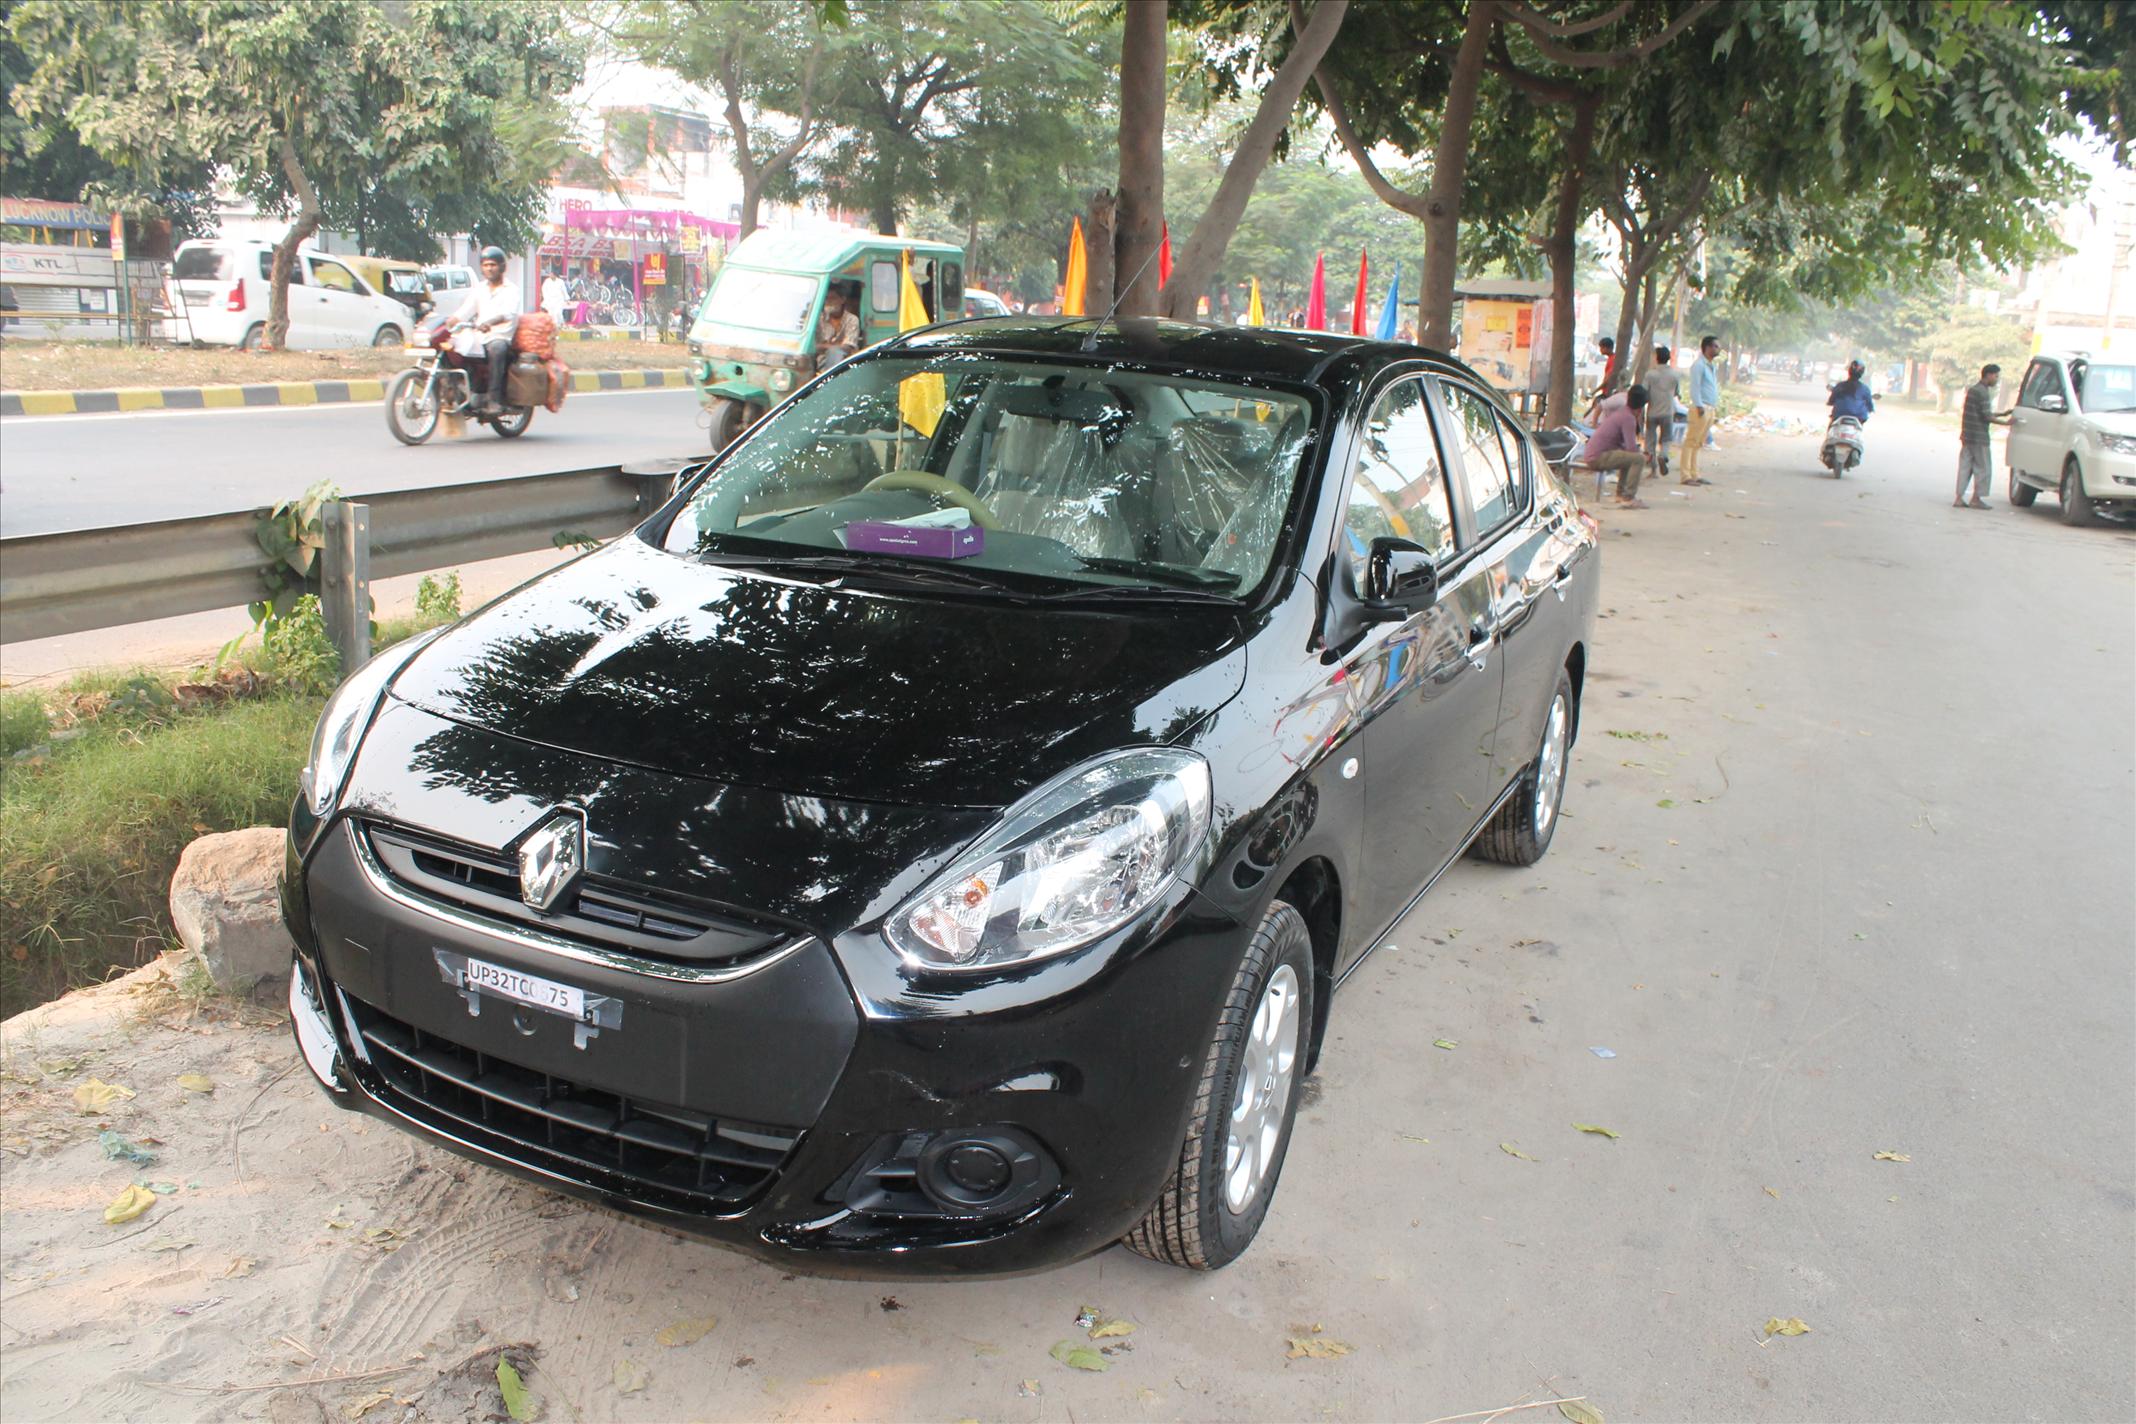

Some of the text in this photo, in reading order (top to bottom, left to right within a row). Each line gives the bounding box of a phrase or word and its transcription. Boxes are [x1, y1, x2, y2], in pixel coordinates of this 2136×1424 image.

[559, 198, 593, 211] HERO
[3, 203, 112, 225] LUCKNOW POLIC
[33, 258, 63, 269] KTL
